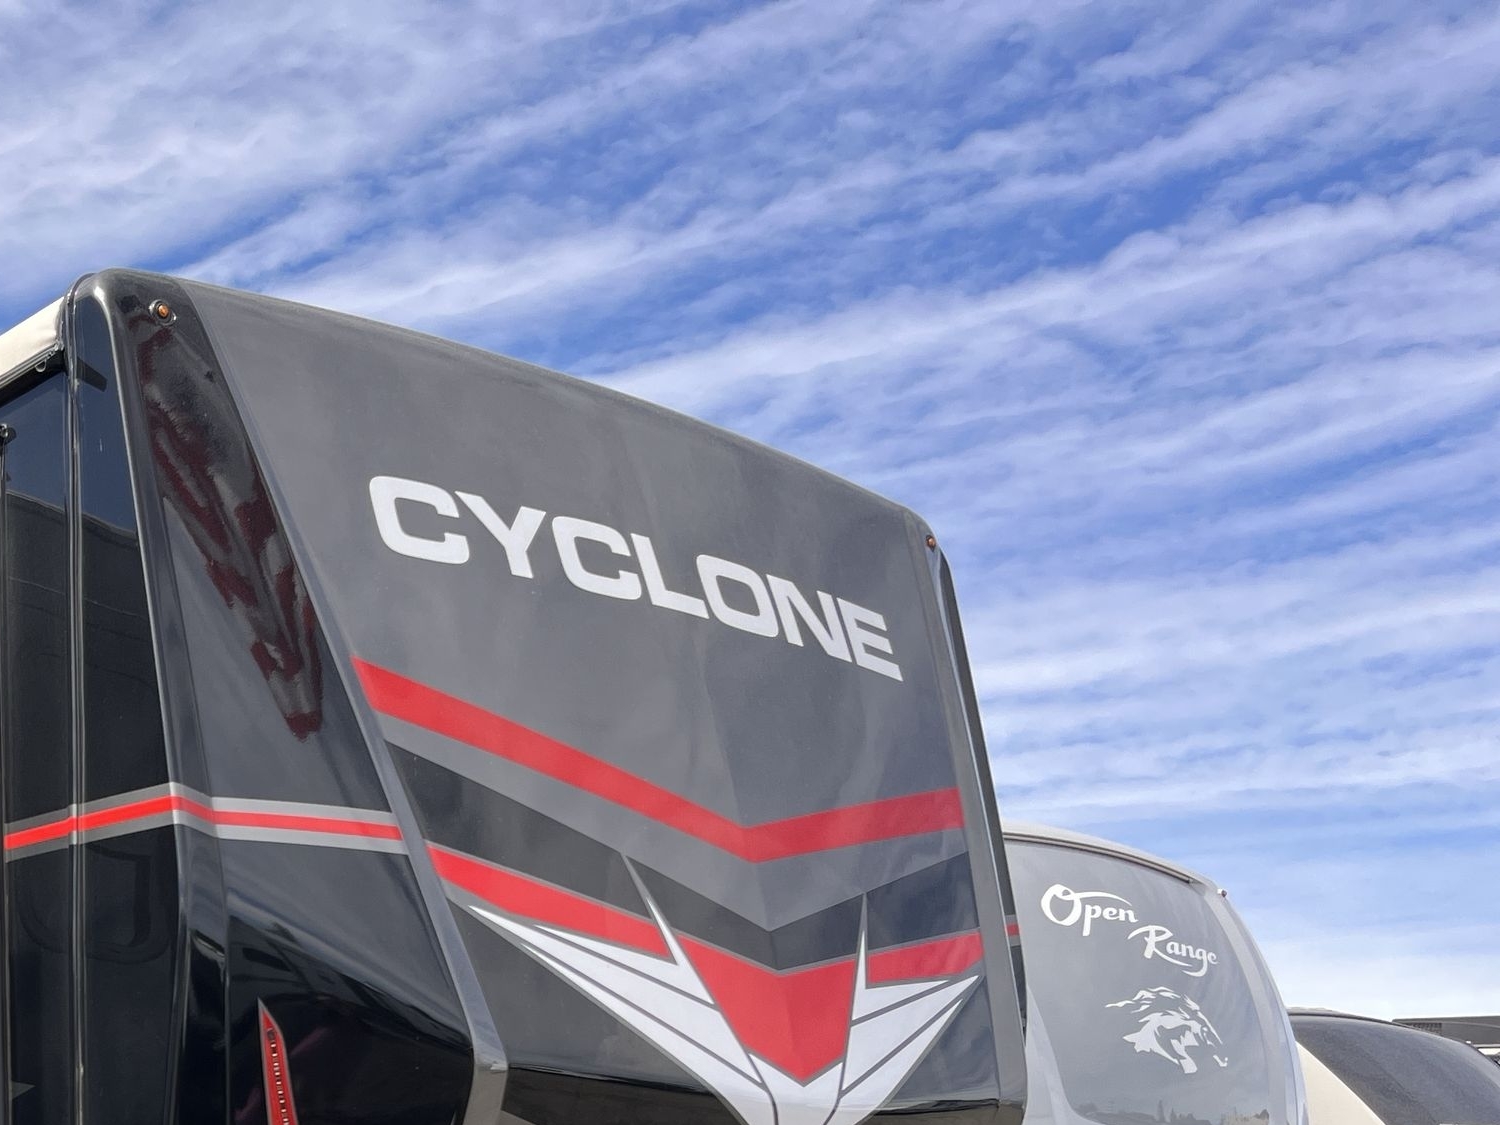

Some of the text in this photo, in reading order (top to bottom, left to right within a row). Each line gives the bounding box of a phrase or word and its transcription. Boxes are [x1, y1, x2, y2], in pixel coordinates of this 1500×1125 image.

[369, 475, 903, 682] CYCLONE
[1041, 884, 1138, 936] Open
[1127, 925, 1218, 977] Range
